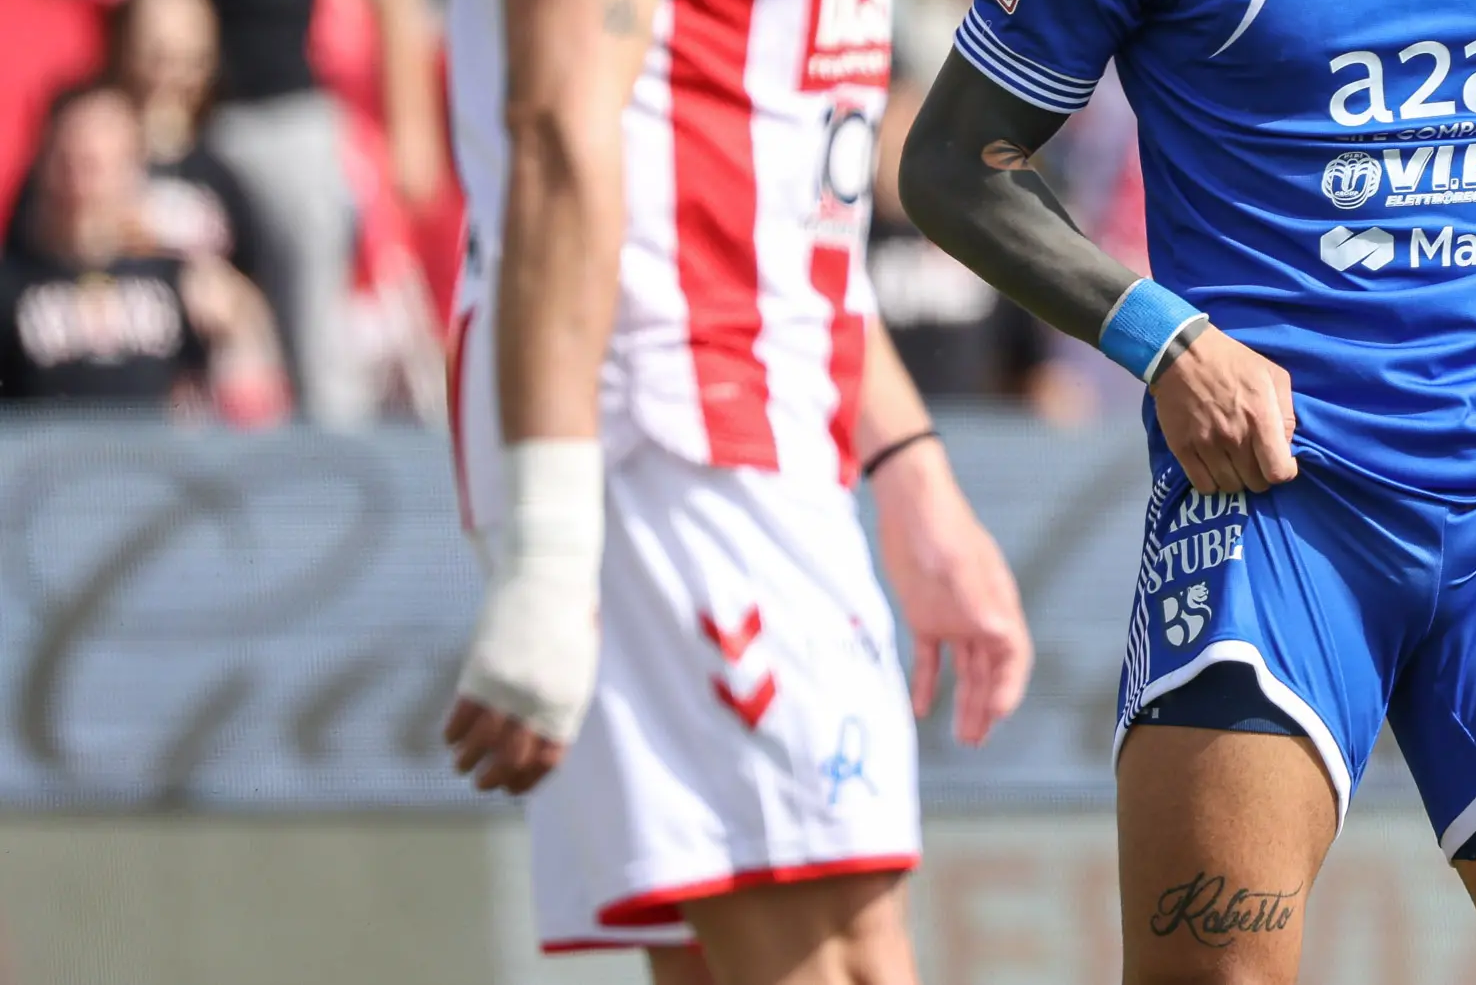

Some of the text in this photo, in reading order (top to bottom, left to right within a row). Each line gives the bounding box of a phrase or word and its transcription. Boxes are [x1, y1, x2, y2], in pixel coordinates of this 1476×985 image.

[1168, 488, 1249, 534] RDA
[1146, 524, 1244, 595] STUBE
[1150, 872, 1303, 948] Roberto
